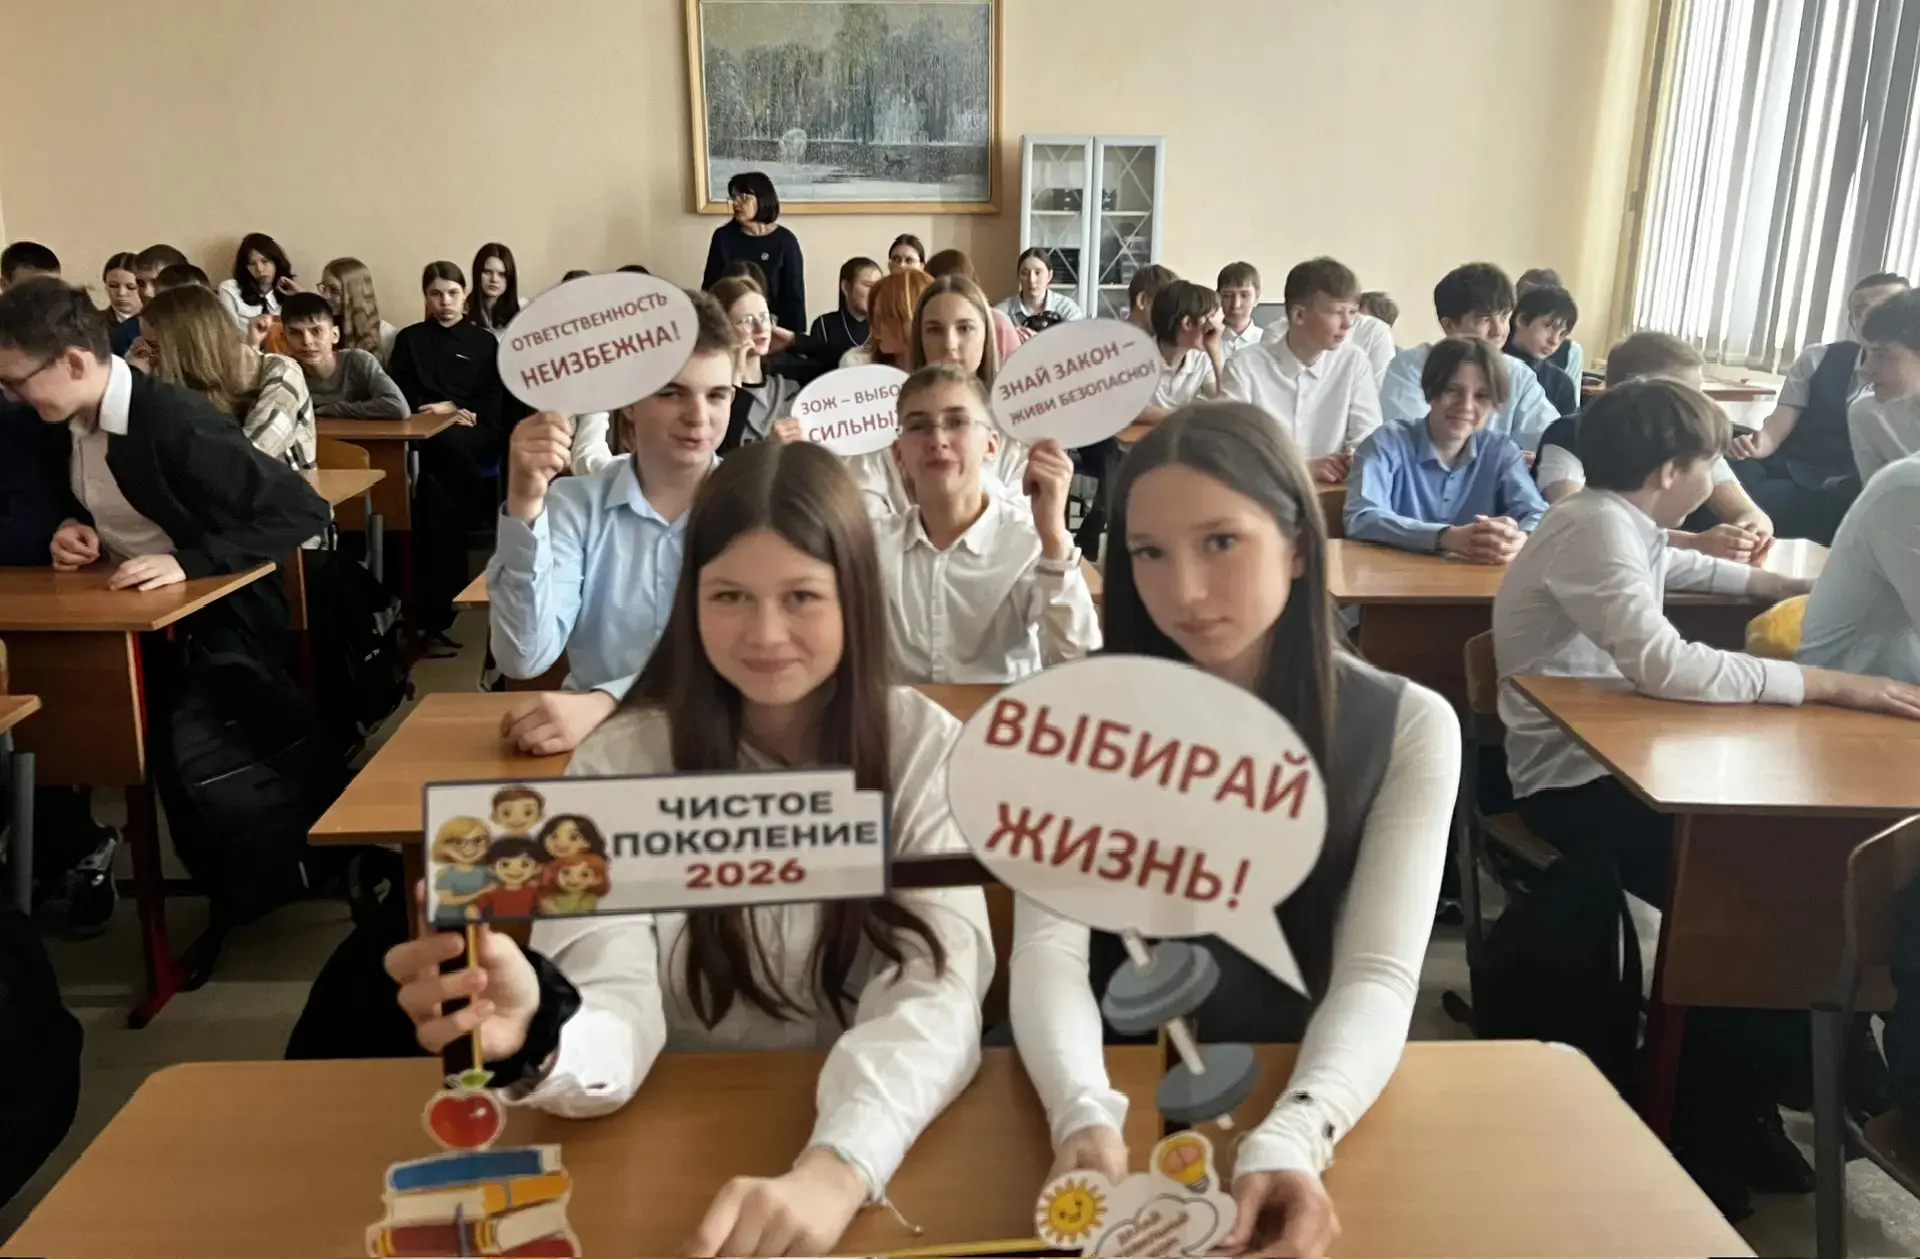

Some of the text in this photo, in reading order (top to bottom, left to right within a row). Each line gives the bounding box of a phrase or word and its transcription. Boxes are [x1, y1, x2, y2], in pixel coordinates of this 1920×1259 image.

[512, 292, 668, 352] ОТВЕТСТВЕННОСТЬ
[520, 320, 681, 390] НЕИЗБЕЖНА!
[999, 366, 1052, 400] ЗНАЙ
[1053, 341, 1120, 380] ЗАКОН
[800, 396, 838, 415] ЗОЖ
[854, 384, 902, 405] ВЫБО
[1009, 359, 1157, 426] ЖИВИ БЕЗОПАСНО!
[809, 410, 898, 443] СИЛЬНЫ
[984, 697, 1312, 819] ВЫБИРАЙ
[658, 791, 833, 821] ЧИСТОЕ
[612, 820, 879, 858] ПОКОЛЕНИЕ
[984, 801, 1251, 909] ЖИЗНЬ!
[685, 858, 807, 890] 2026
